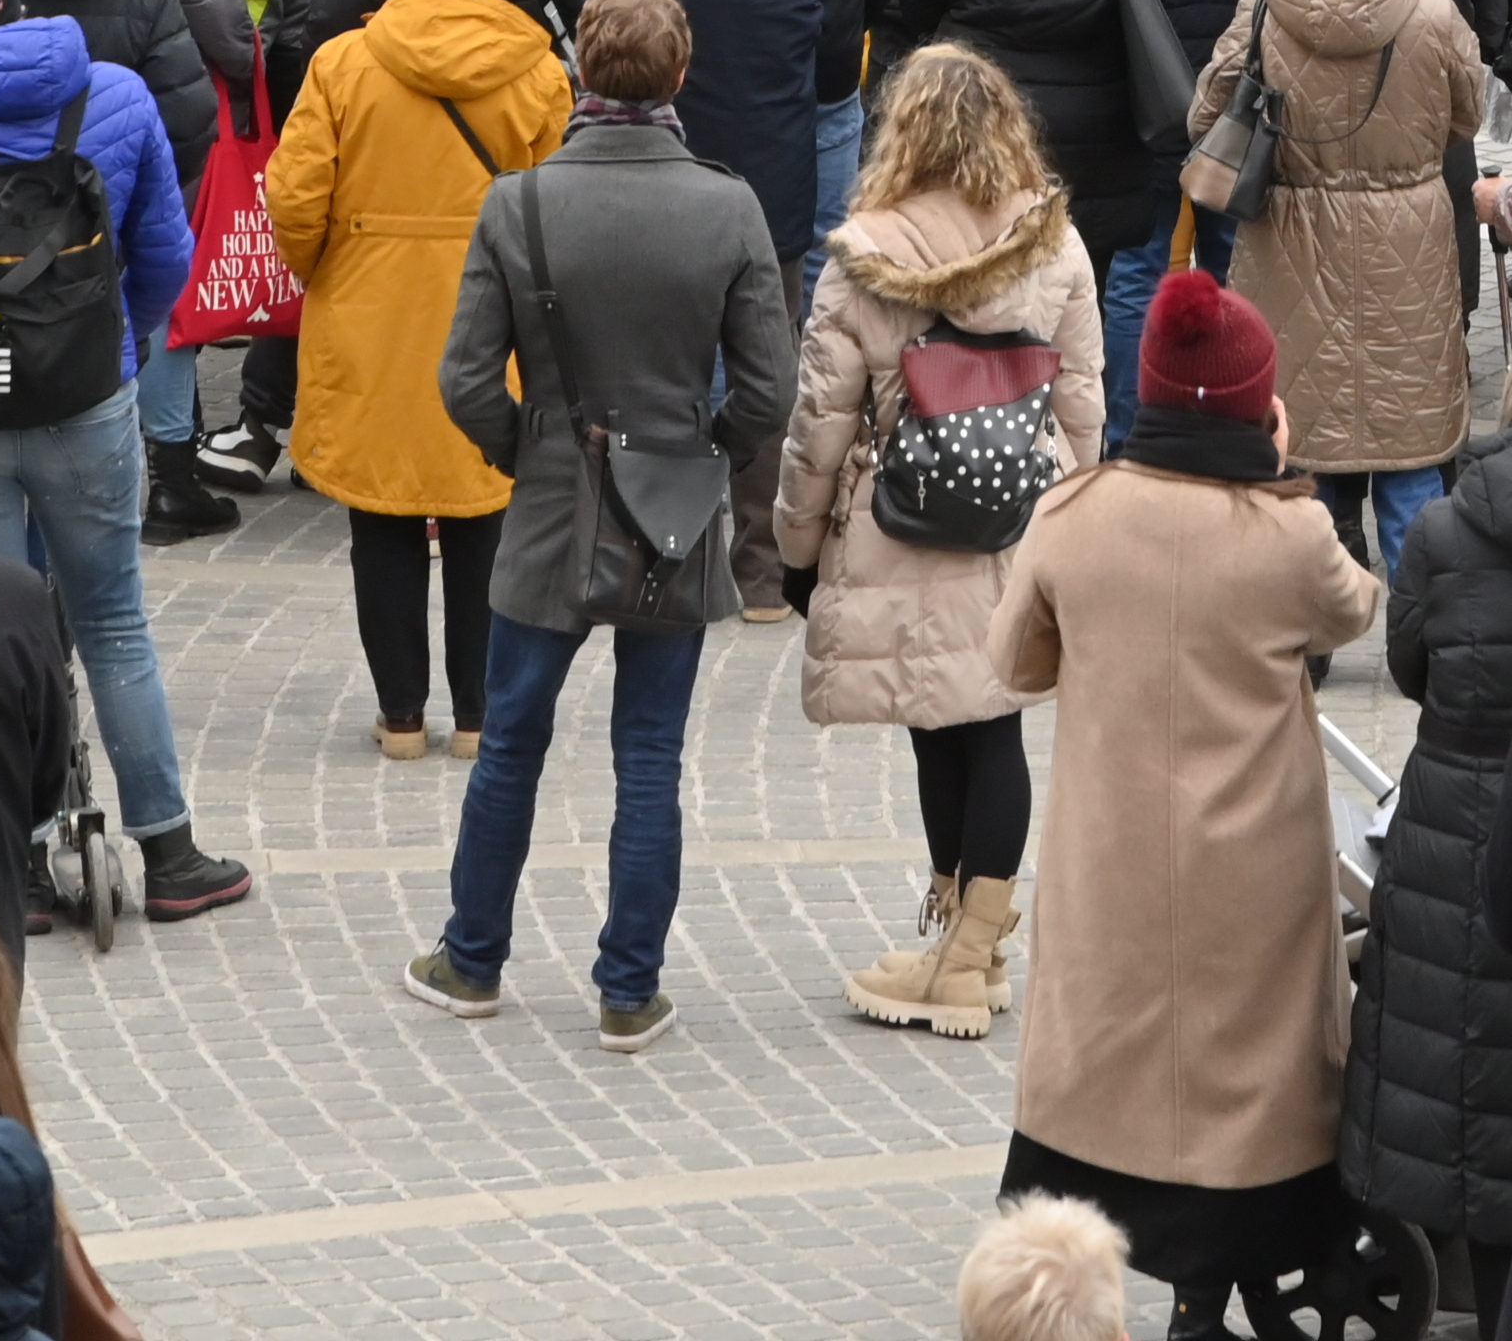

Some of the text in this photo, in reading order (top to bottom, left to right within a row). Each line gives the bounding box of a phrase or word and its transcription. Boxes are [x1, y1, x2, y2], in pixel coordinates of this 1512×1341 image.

[222, 233, 276, 256] HOLID
[207, 258, 244, 280] AND
[247, 256, 260, 278] A
[195, 279, 258, 312] NEW
